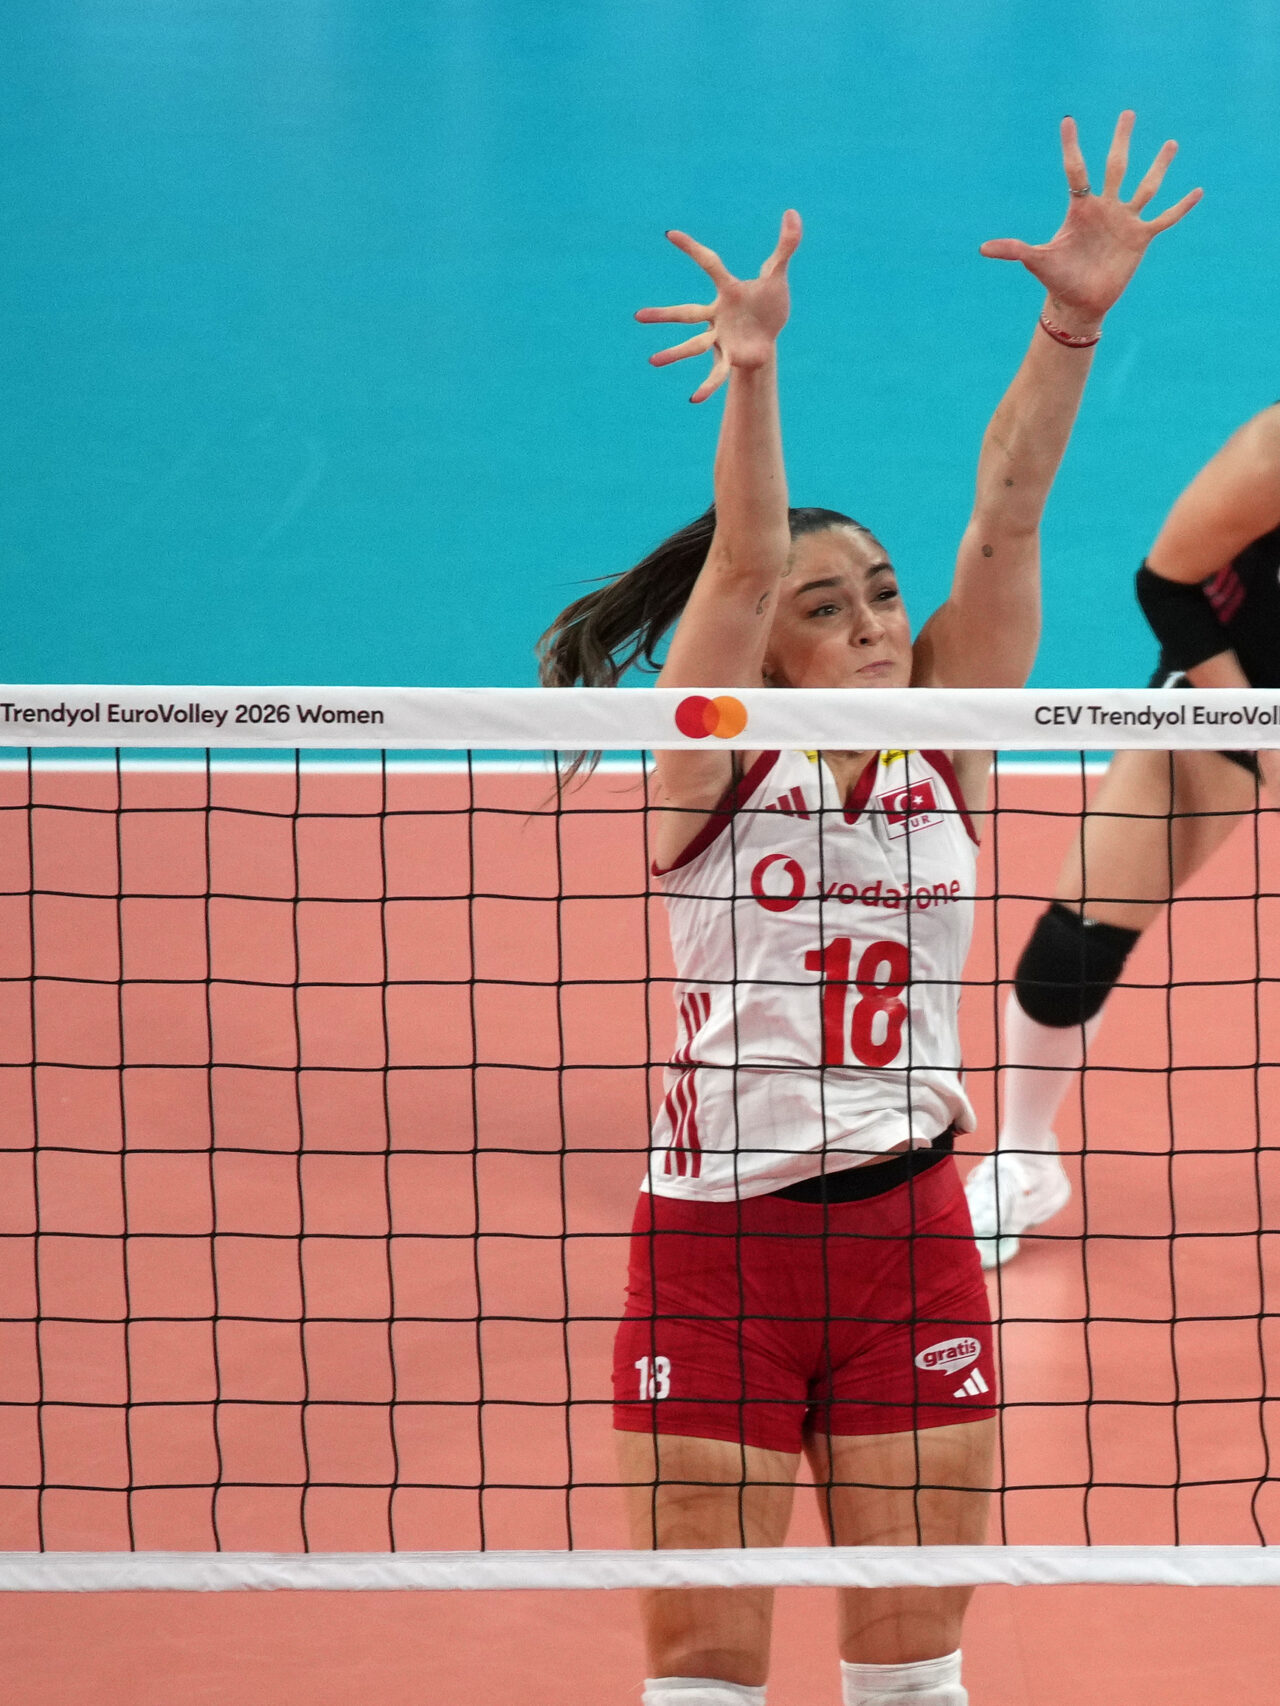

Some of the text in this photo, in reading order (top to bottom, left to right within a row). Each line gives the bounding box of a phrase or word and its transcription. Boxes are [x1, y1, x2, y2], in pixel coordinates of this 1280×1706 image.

[0, 702, 384, 728] Trendyol EuroVolley 2026 Women
[1035, 705, 1083, 725] CEV
[1087, 705, 1186, 730] Trendyol
[804, 936, 910, 1067] 18
[923, 1339, 977, 1368] gratis
